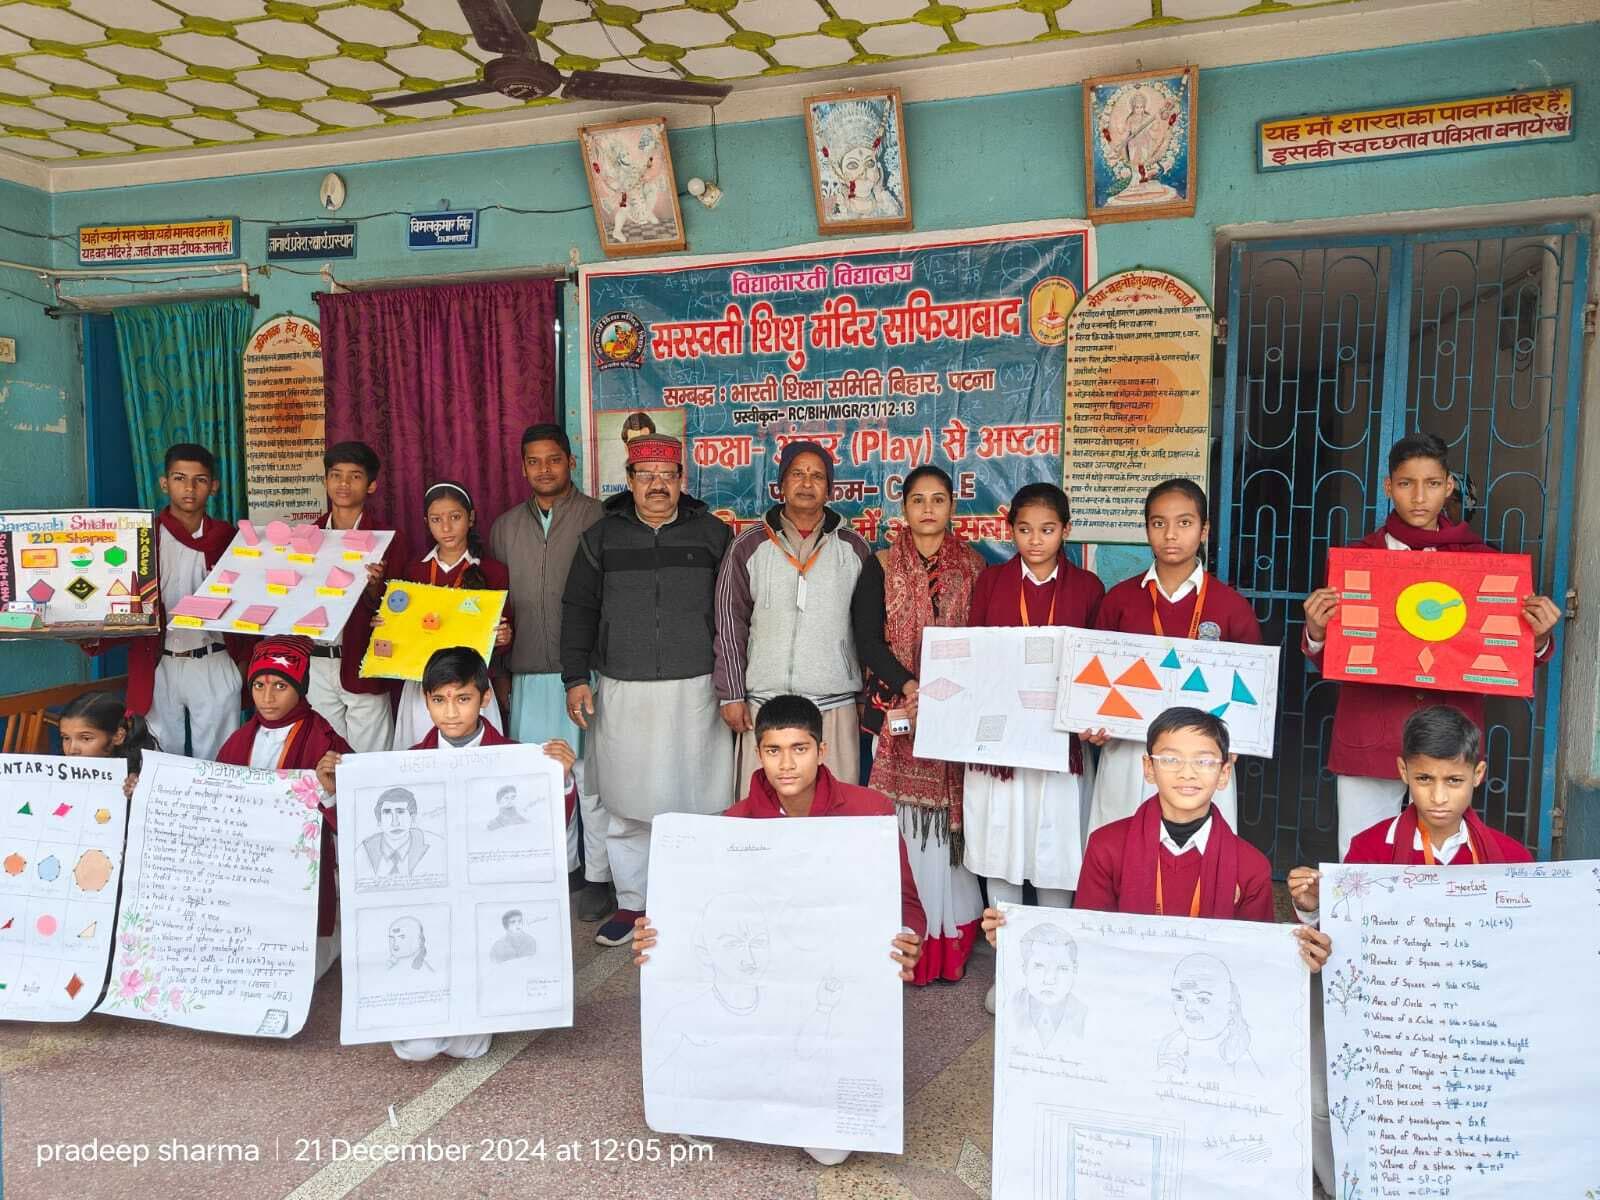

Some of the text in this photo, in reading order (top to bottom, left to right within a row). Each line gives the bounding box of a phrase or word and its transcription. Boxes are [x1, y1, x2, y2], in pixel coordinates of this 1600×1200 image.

[1264, 124, 1301, 141] यह
[1338, 112, 1404, 133] शारदा
[1406, 108, 1435, 127] का
[1438, 102, 1495, 121] पावन
[1495, 96, 1545, 118] मंदिर
[1268, 140, 1336, 165] इसकी
[1432, 125, 1493, 144] पवित्रता
[457, 215, 472, 231] सिंह
[121, 230, 136, 242] मत
[731, 262, 913, 297] विद्याभारती विद्यालय
[651, 303, 745, 361] सरस्वती
[750, 301, 806, 372] शिशु
[809, 294, 877, 350] मंदिर
[881, 288, 1023, 348] सफियाबाद
[731, 375, 778, 402] भारती
[781, 373, 824, 401] शिक्षा
[827, 369, 883, 398] समिति
[947, 369, 996, 392] पटना
[787, 400, 916, 421] RC/BIH/MGR/31/12-13
[850, 428, 933, 469] (Play)
[941, 418, 968, 461] से
[975, 421, 1061, 461] अष्टम
[70, 515, 118, 530] Shishu
[65, 532, 117, 546] Shapes
[58, 763, 112, 781] SHAPES
[1403, 866, 1440, 888] Some
[1406, 916, 1416, 927] of
[1391, 976, 1400, 987] of
[1391, 996, 1400, 1007] of
[1410, 1047, 1419, 1057] of
[1396, 1064, 1405, 1074] of
